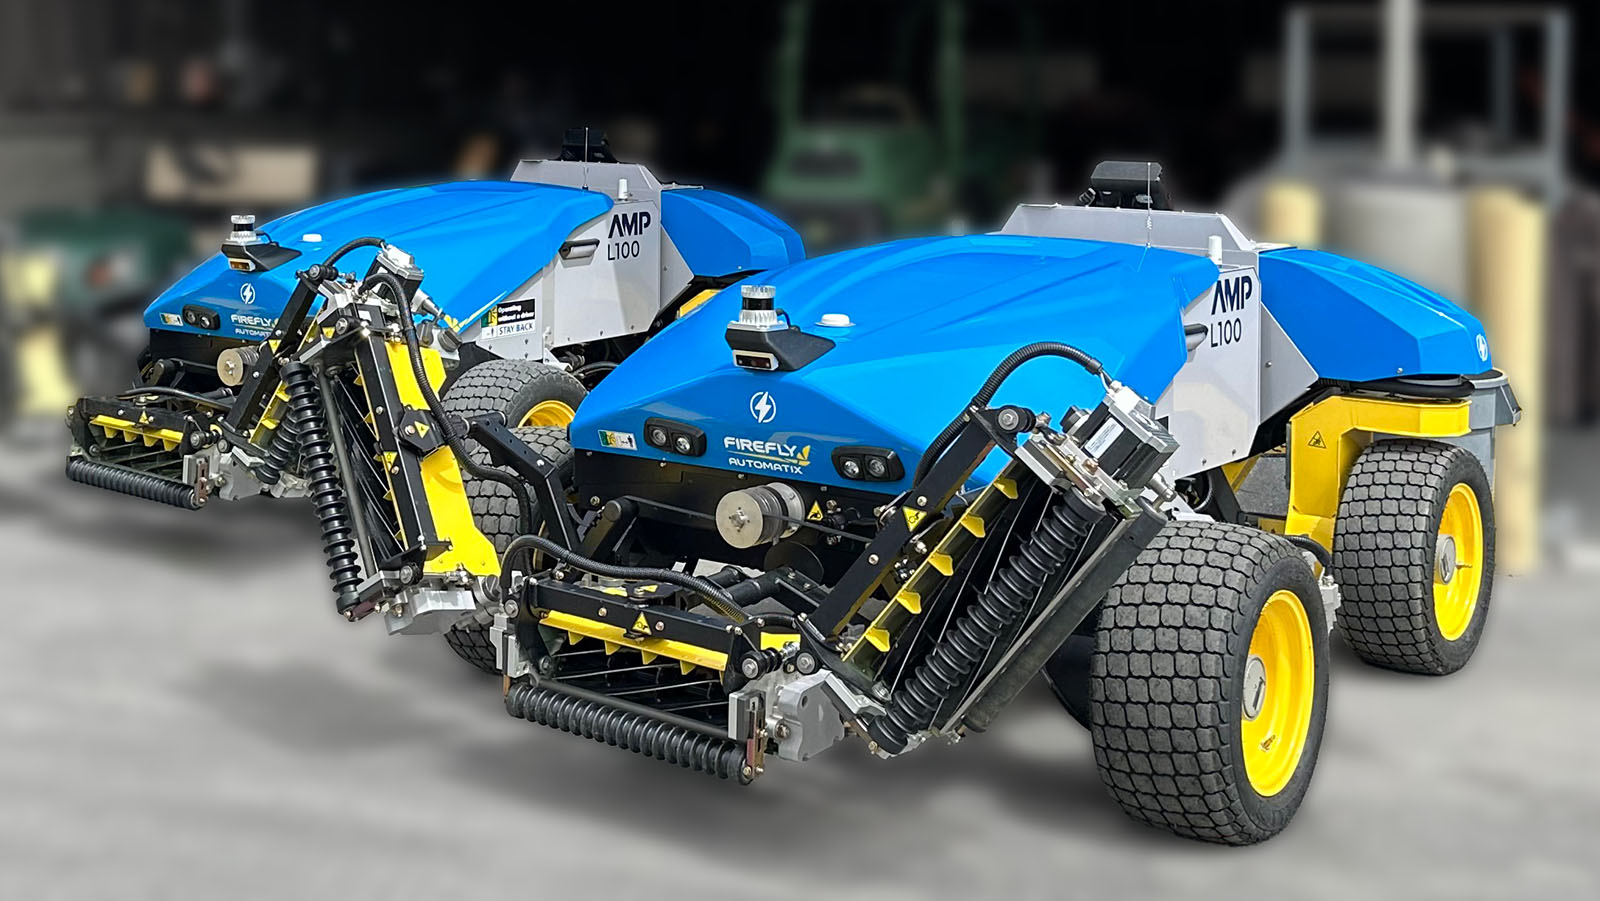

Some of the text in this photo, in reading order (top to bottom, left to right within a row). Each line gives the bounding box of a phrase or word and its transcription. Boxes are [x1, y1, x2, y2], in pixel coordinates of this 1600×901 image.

[608, 211, 651, 238] AMP
[607, 240, 640, 260] L100
[1211, 276, 1252, 315] AMP
[230, 314, 272, 327] FIREFLY
[499, 322, 533, 336] STAY BACK
[1211, 317, 1242, 348] L100
[723, 436, 797, 457] FIREFLY
[728, 457, 804, 475] AUTOMATIX
